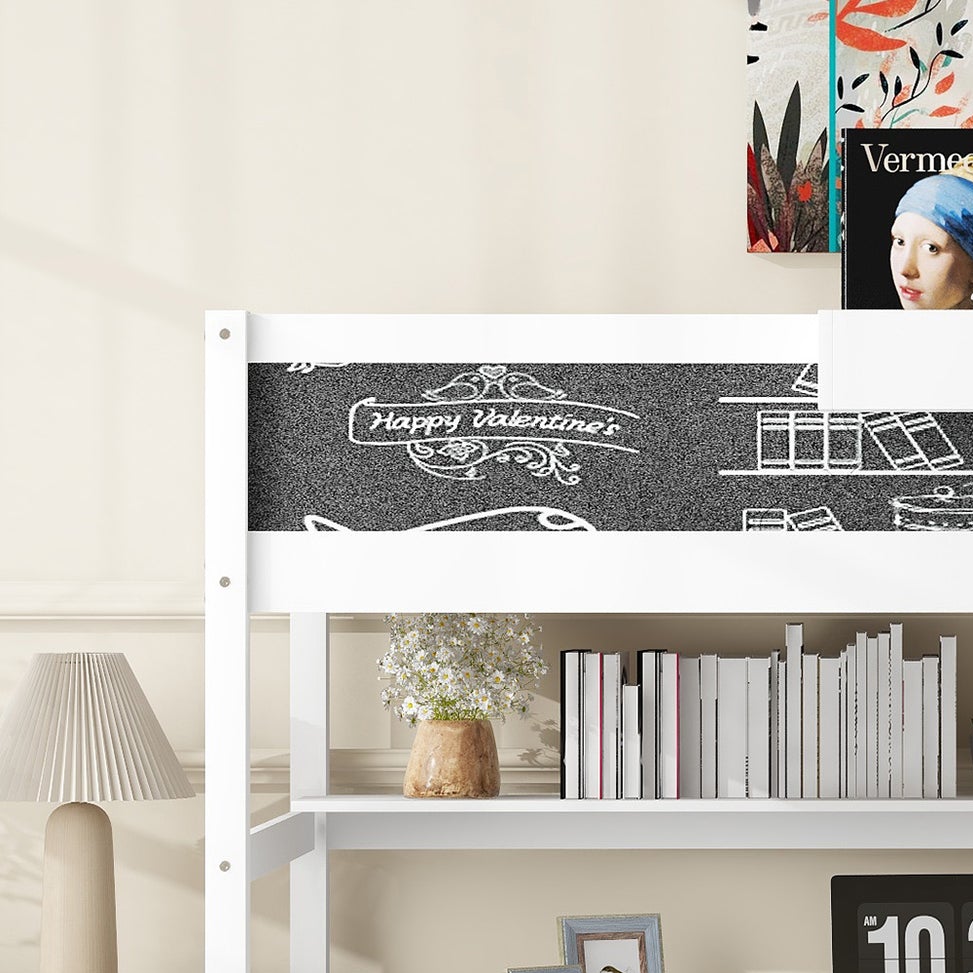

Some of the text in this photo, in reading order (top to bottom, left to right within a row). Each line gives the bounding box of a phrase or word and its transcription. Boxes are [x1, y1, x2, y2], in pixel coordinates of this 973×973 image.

[369, 408, 621, 436] Happy Valentine's
[863, 915, 877, 927] AM
